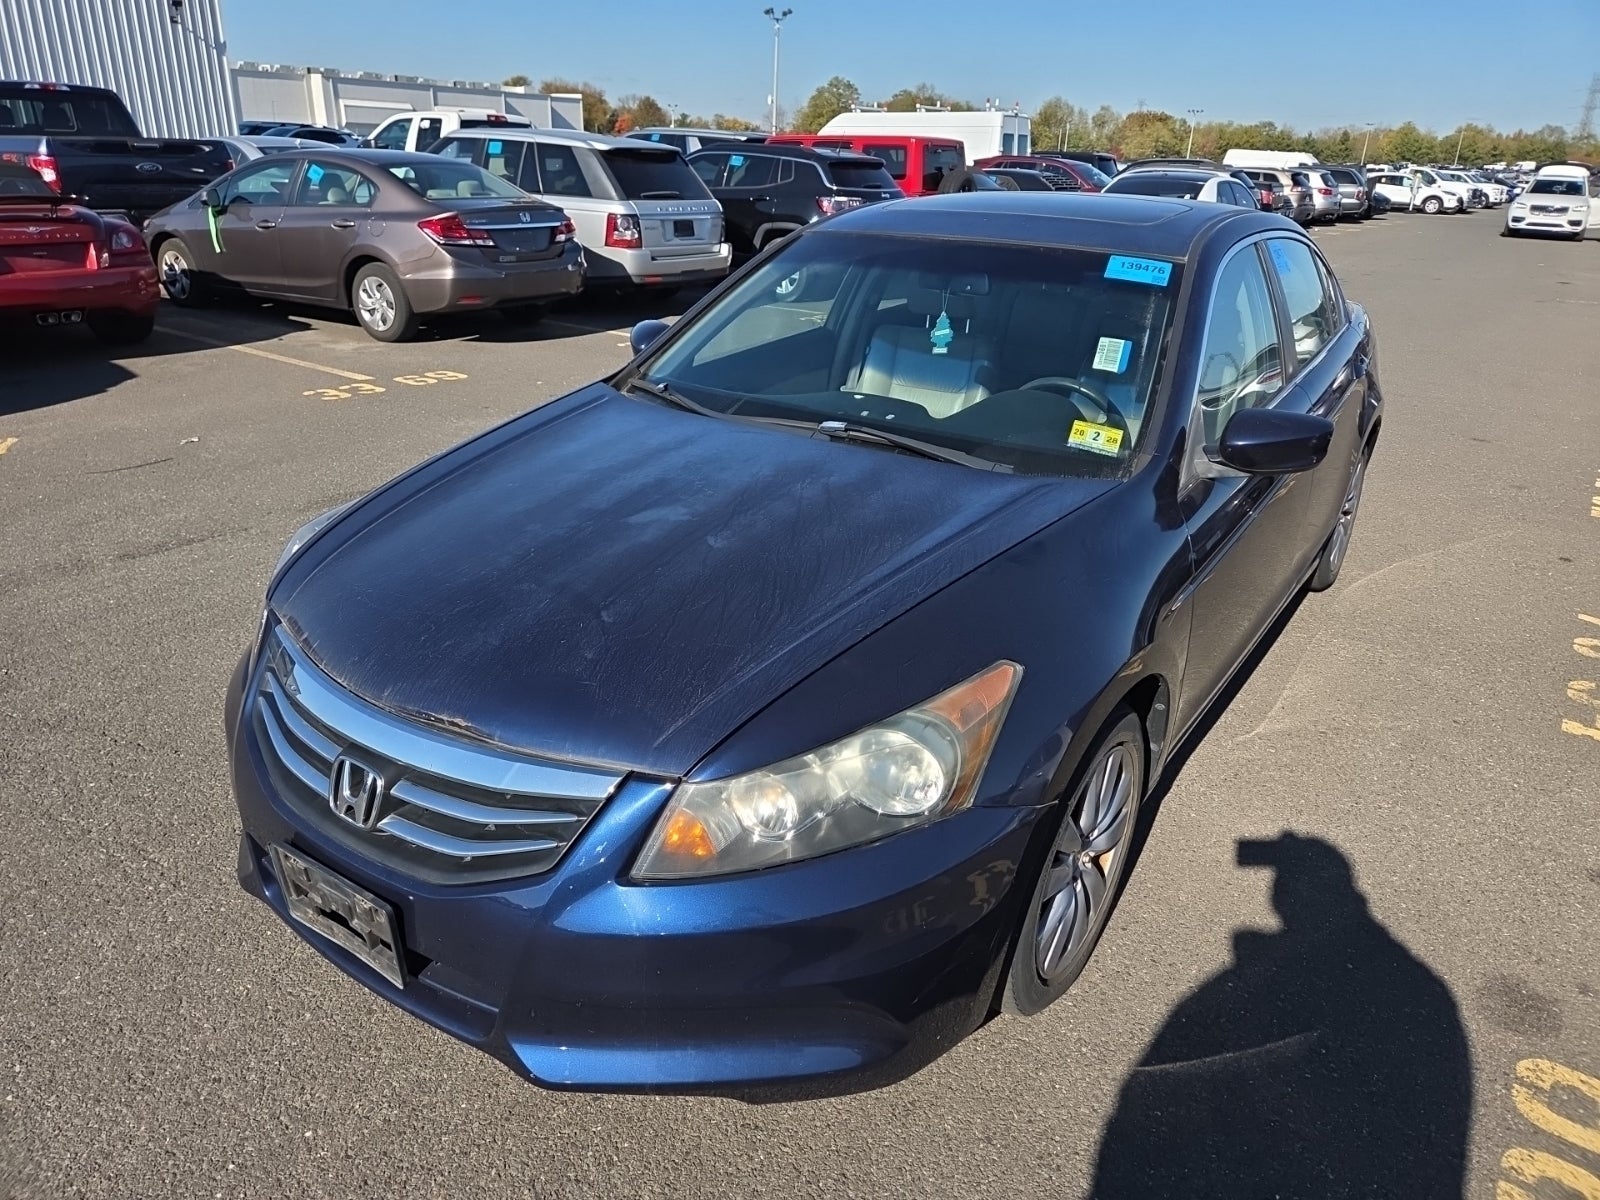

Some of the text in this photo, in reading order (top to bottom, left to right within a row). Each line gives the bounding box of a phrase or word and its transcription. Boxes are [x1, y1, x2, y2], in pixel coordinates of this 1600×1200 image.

[1120, 261, 1166, 275] 139476
[1073, 428, 1118, 446] 20 2 28
